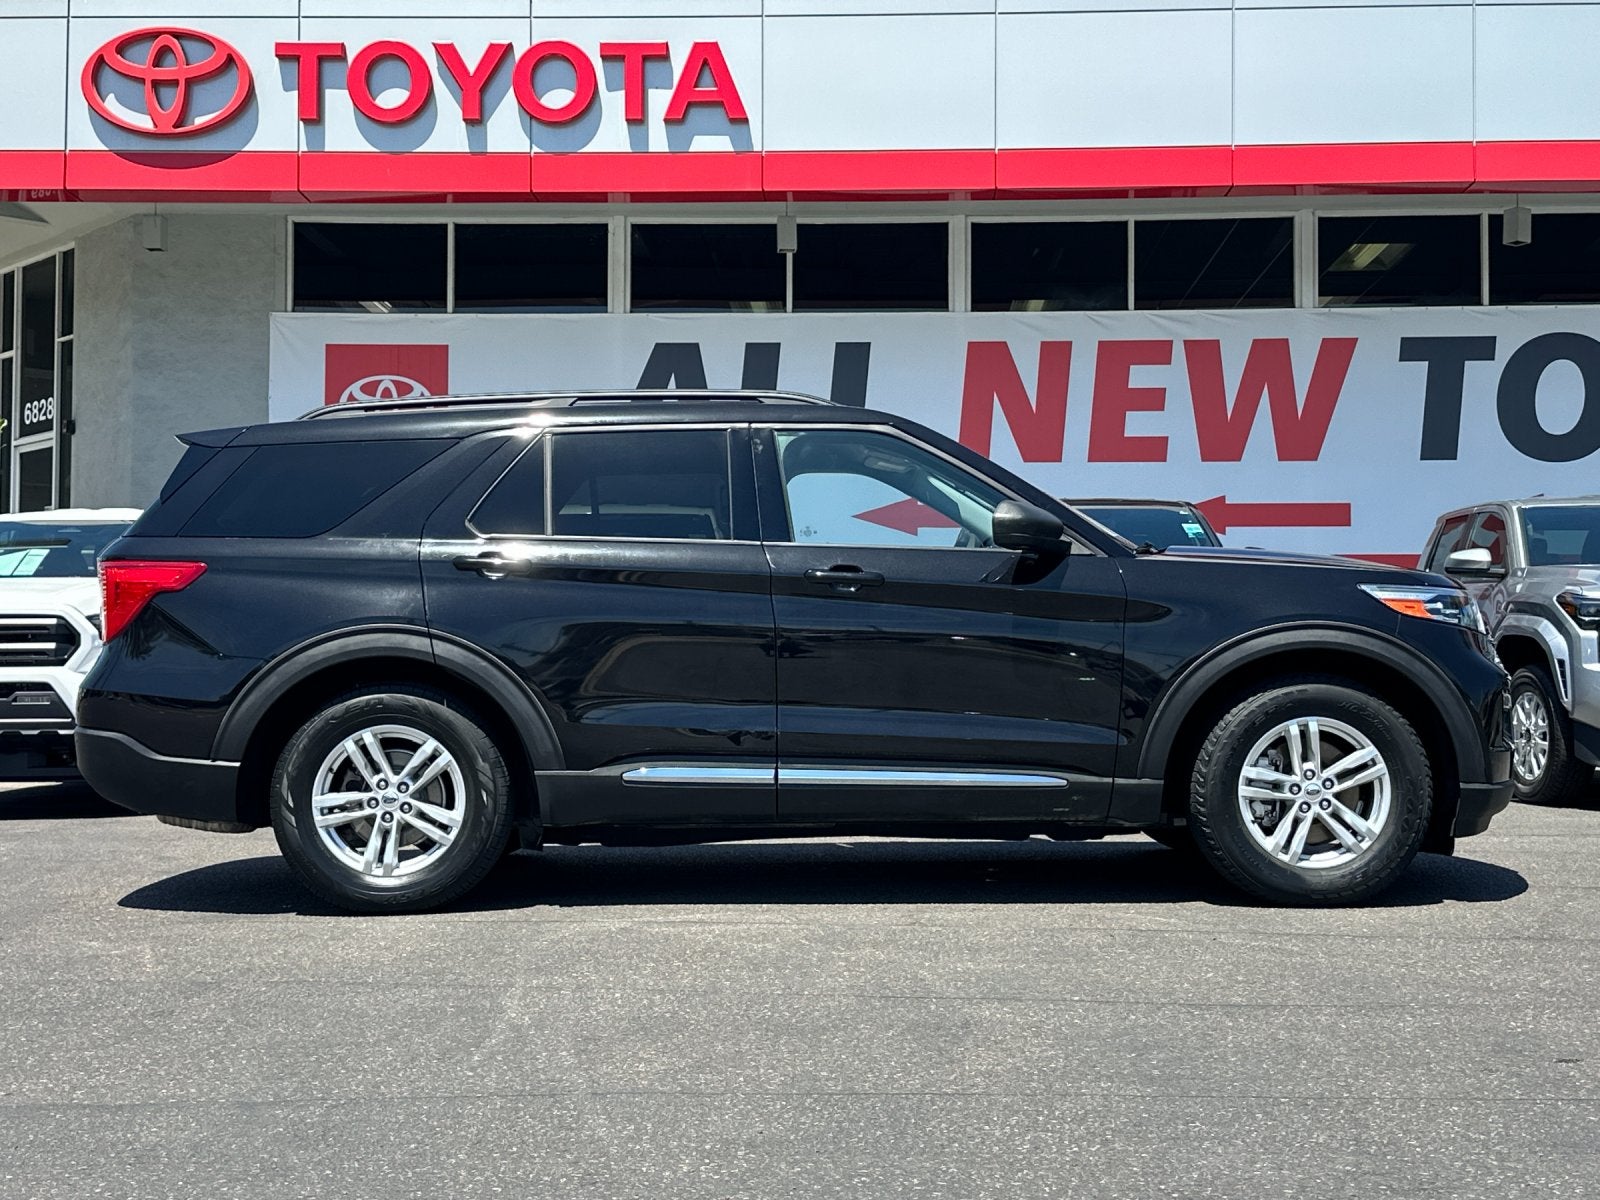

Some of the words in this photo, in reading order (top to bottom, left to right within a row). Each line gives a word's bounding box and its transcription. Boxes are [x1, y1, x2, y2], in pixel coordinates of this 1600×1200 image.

[275, 40, 749, 125] TOYOTA
[24, 397, 54, 425] 6828
[959, 337, 1358, 462] NEW
[1399, 332, 1600, 462] TO
